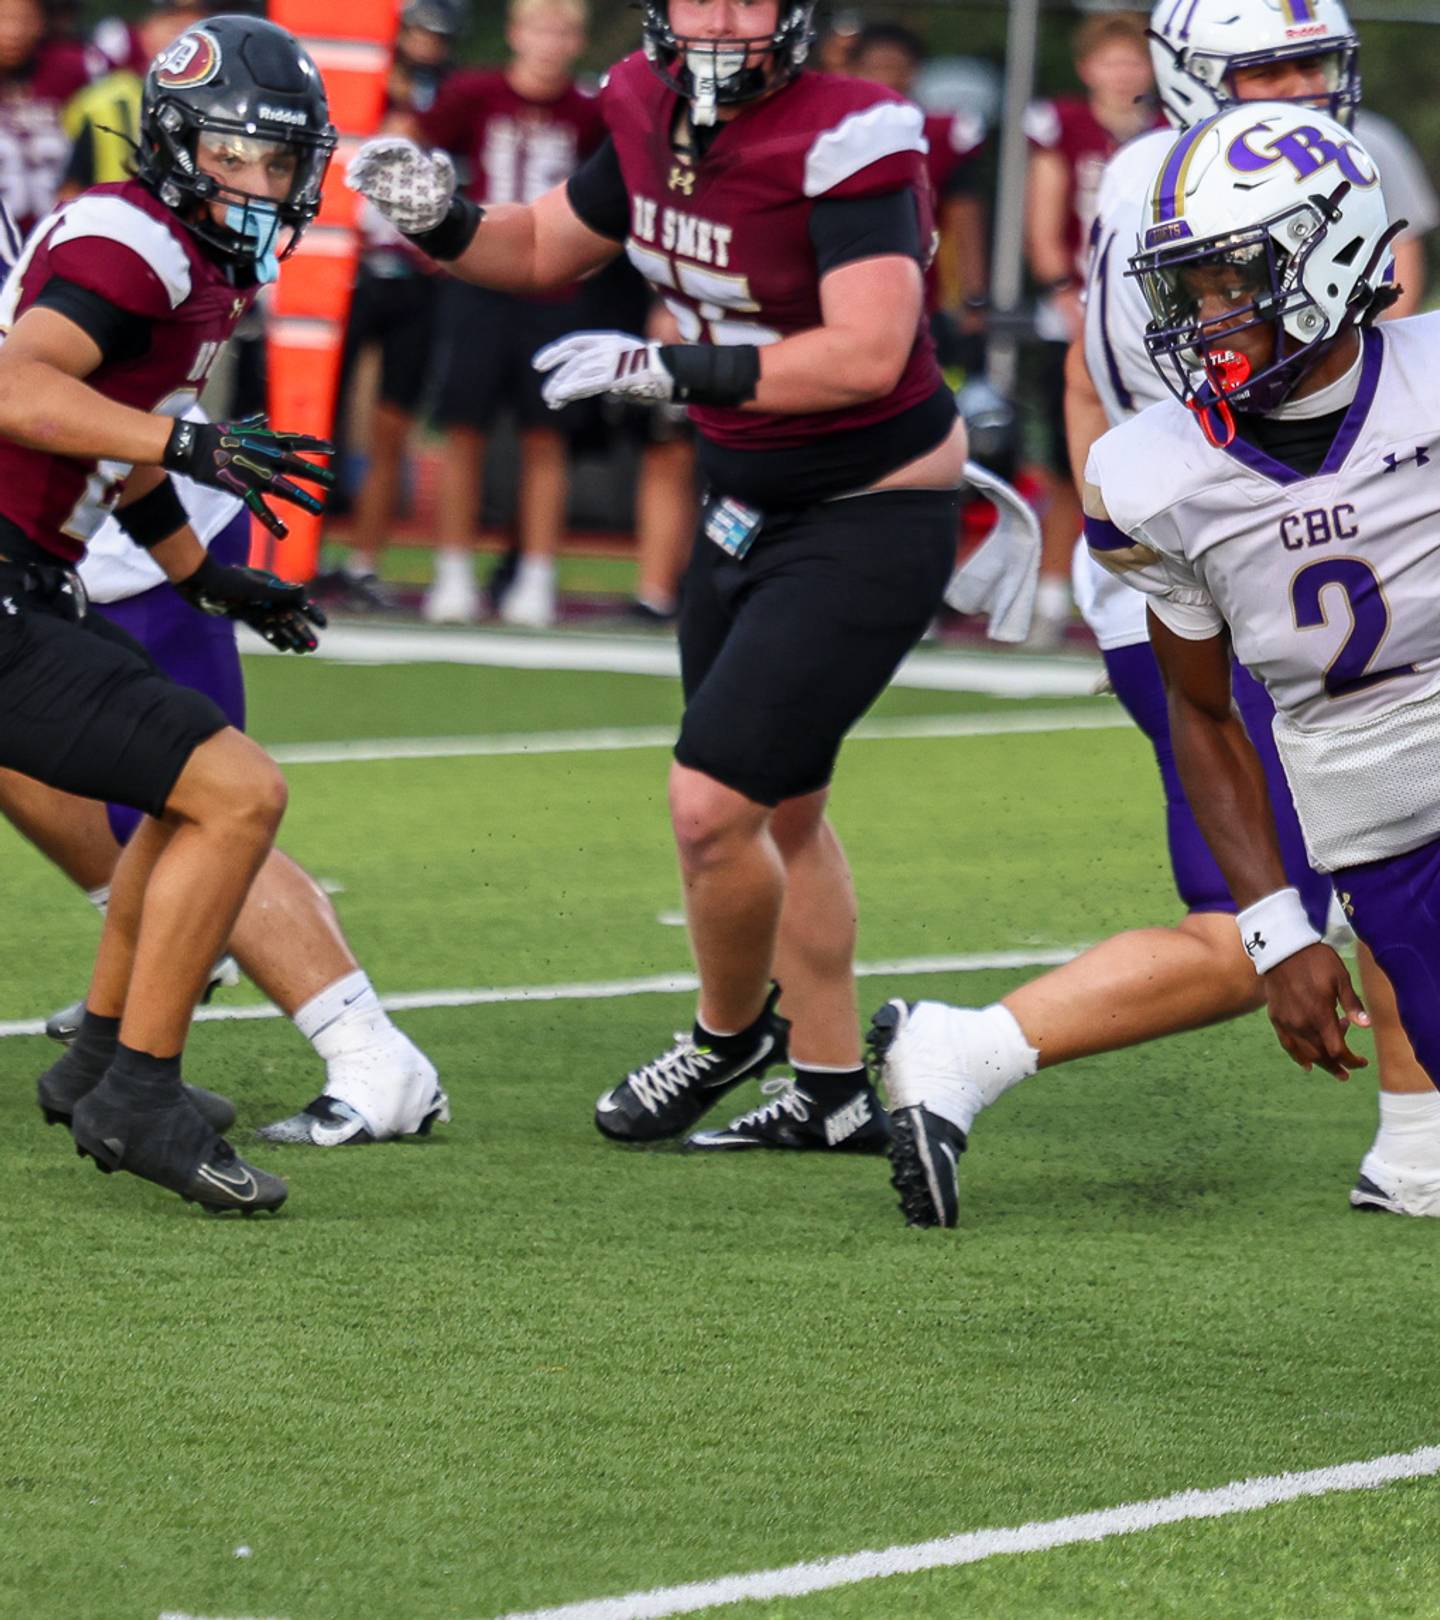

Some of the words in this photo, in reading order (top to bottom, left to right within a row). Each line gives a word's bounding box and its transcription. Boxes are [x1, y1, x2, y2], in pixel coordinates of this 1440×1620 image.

[1225, 122, 1381, 191] CBC
[661, 207, 733, 268] SMET
[1279, 503, 1360, 551] CBC
[1288, 555, 1421, 702] 2
[824, 1093, 873, 1147] NIKE
